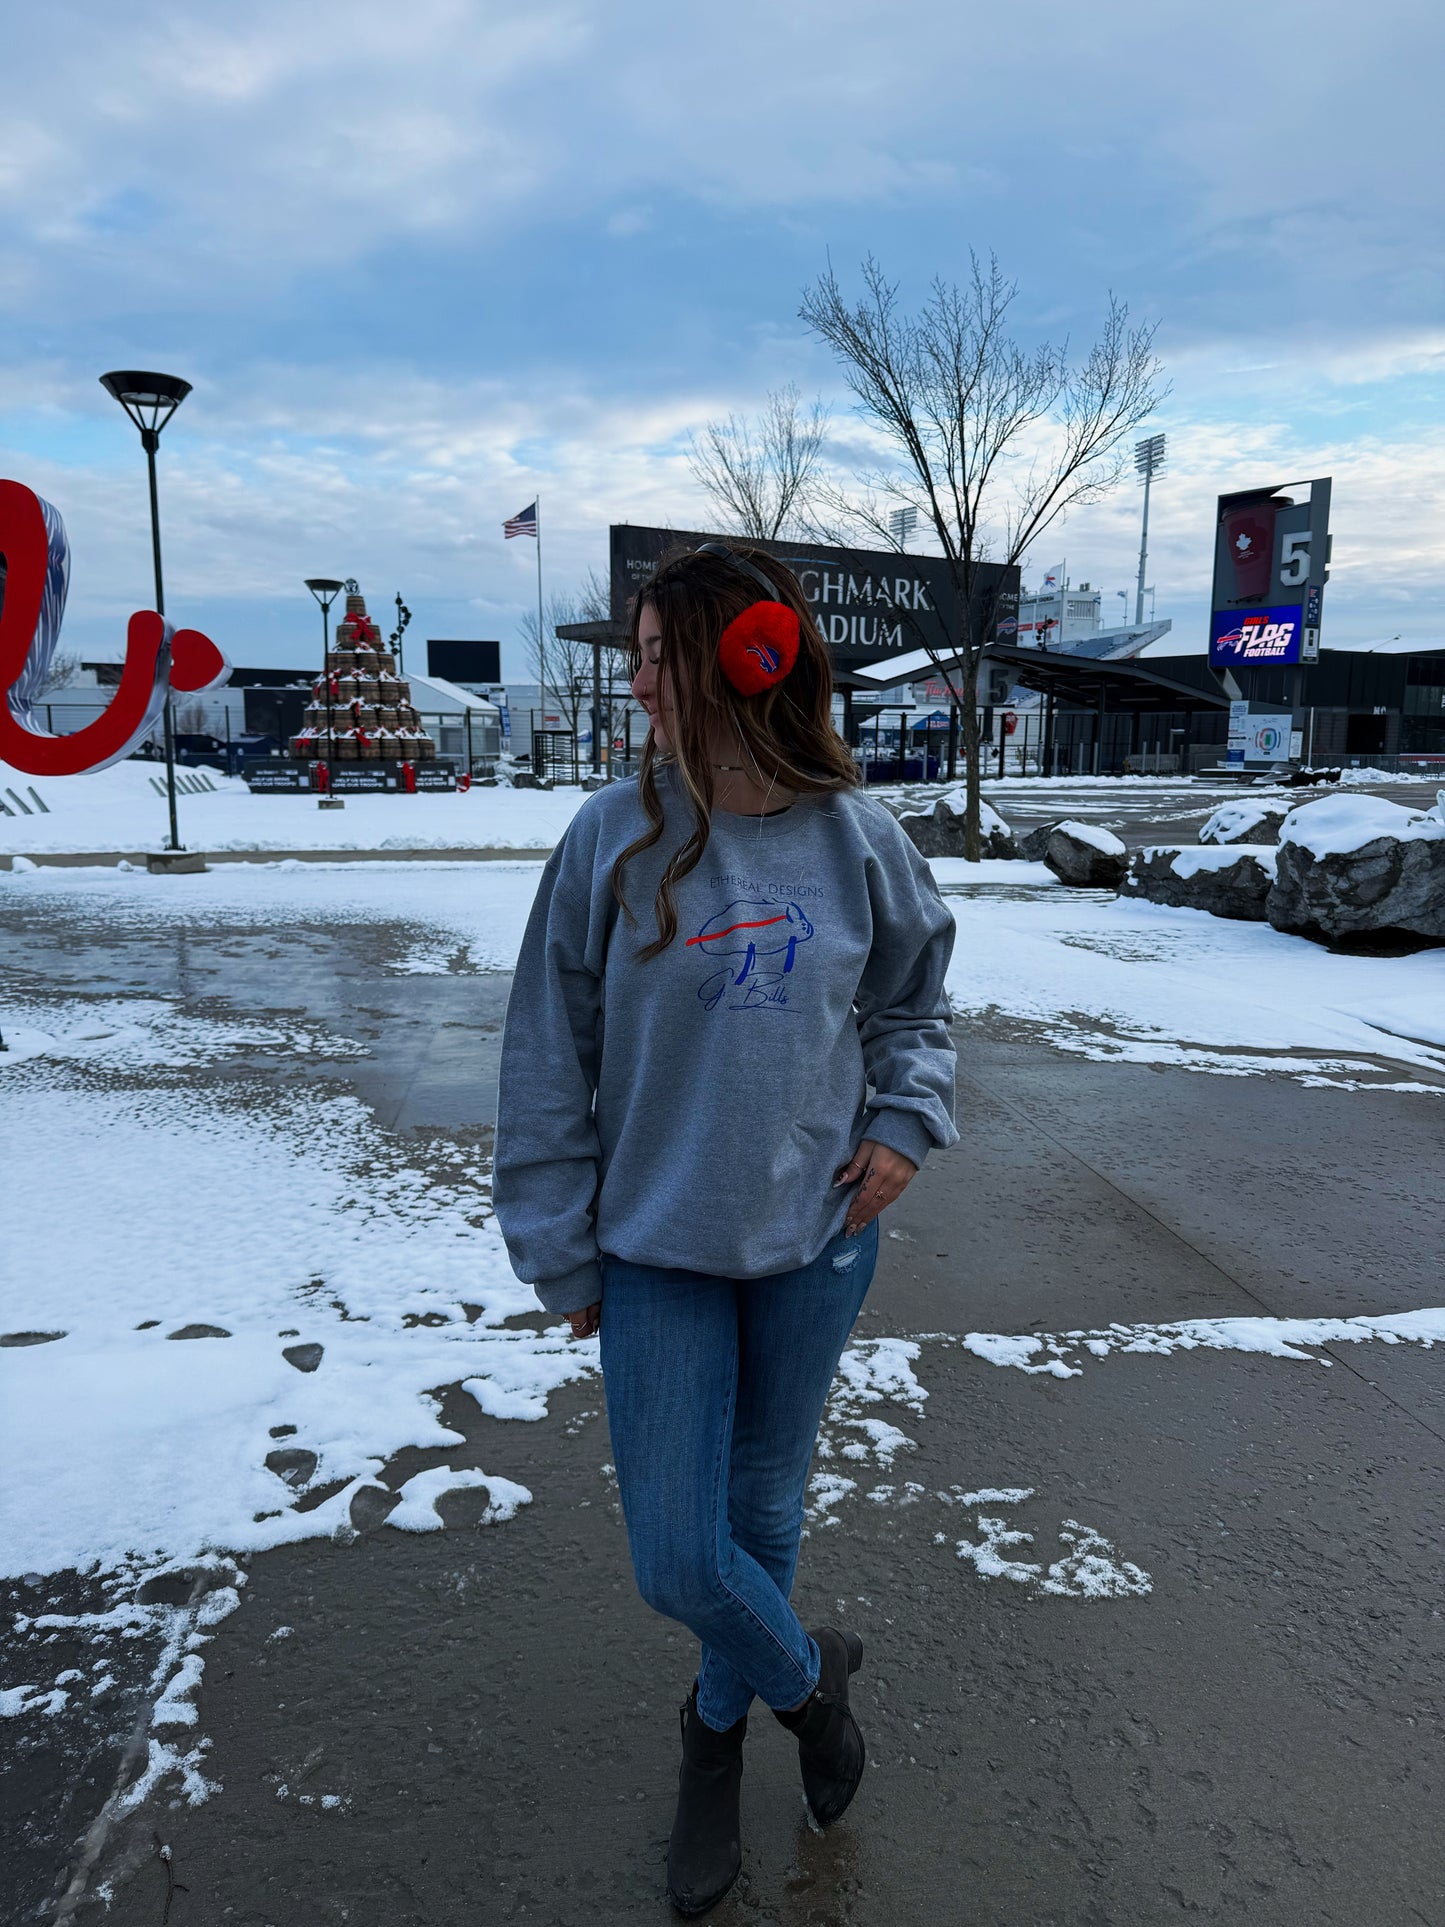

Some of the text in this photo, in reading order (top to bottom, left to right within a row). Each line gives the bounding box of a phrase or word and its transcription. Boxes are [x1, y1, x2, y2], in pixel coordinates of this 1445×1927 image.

[626, 559, 657, 571] HOME
[1280, 530, 1312, 587] 5
[800, 570, 931, 611] GHMARK
[815, 613, 903, 647] ADIUM
[1243, 615, 1270, 626] GIRLS
[1234, 622, 1295, 654] FLAG
[1243, 647, 1286, 658] FOOTBALL
[990, 668, 1009, 703] 5
[709, 874, 824, 898] ETHEREAL DESIGNS
[737, 971, 797, 1011] Bills
